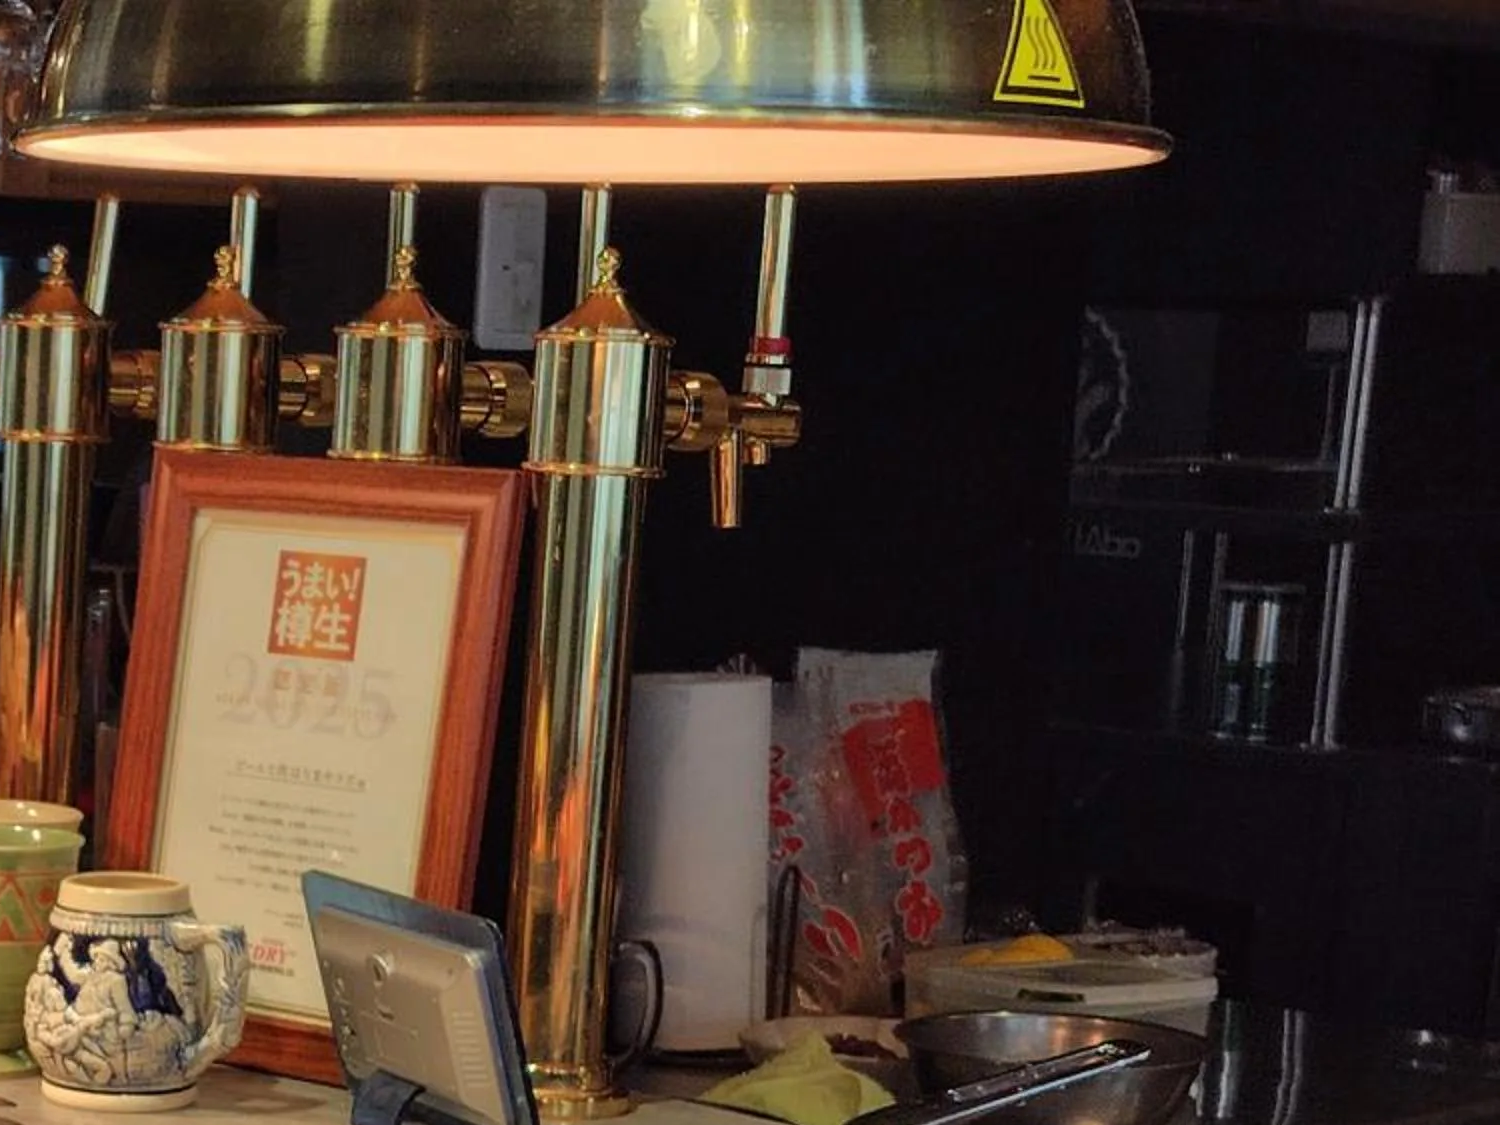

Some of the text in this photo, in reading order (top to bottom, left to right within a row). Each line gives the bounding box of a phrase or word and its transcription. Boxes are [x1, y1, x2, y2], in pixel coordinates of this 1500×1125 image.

[281, 558, 362, 602] うまい!
[275, 597, 353, 653] 樽生
[216, 651, 395, 740] 2025
